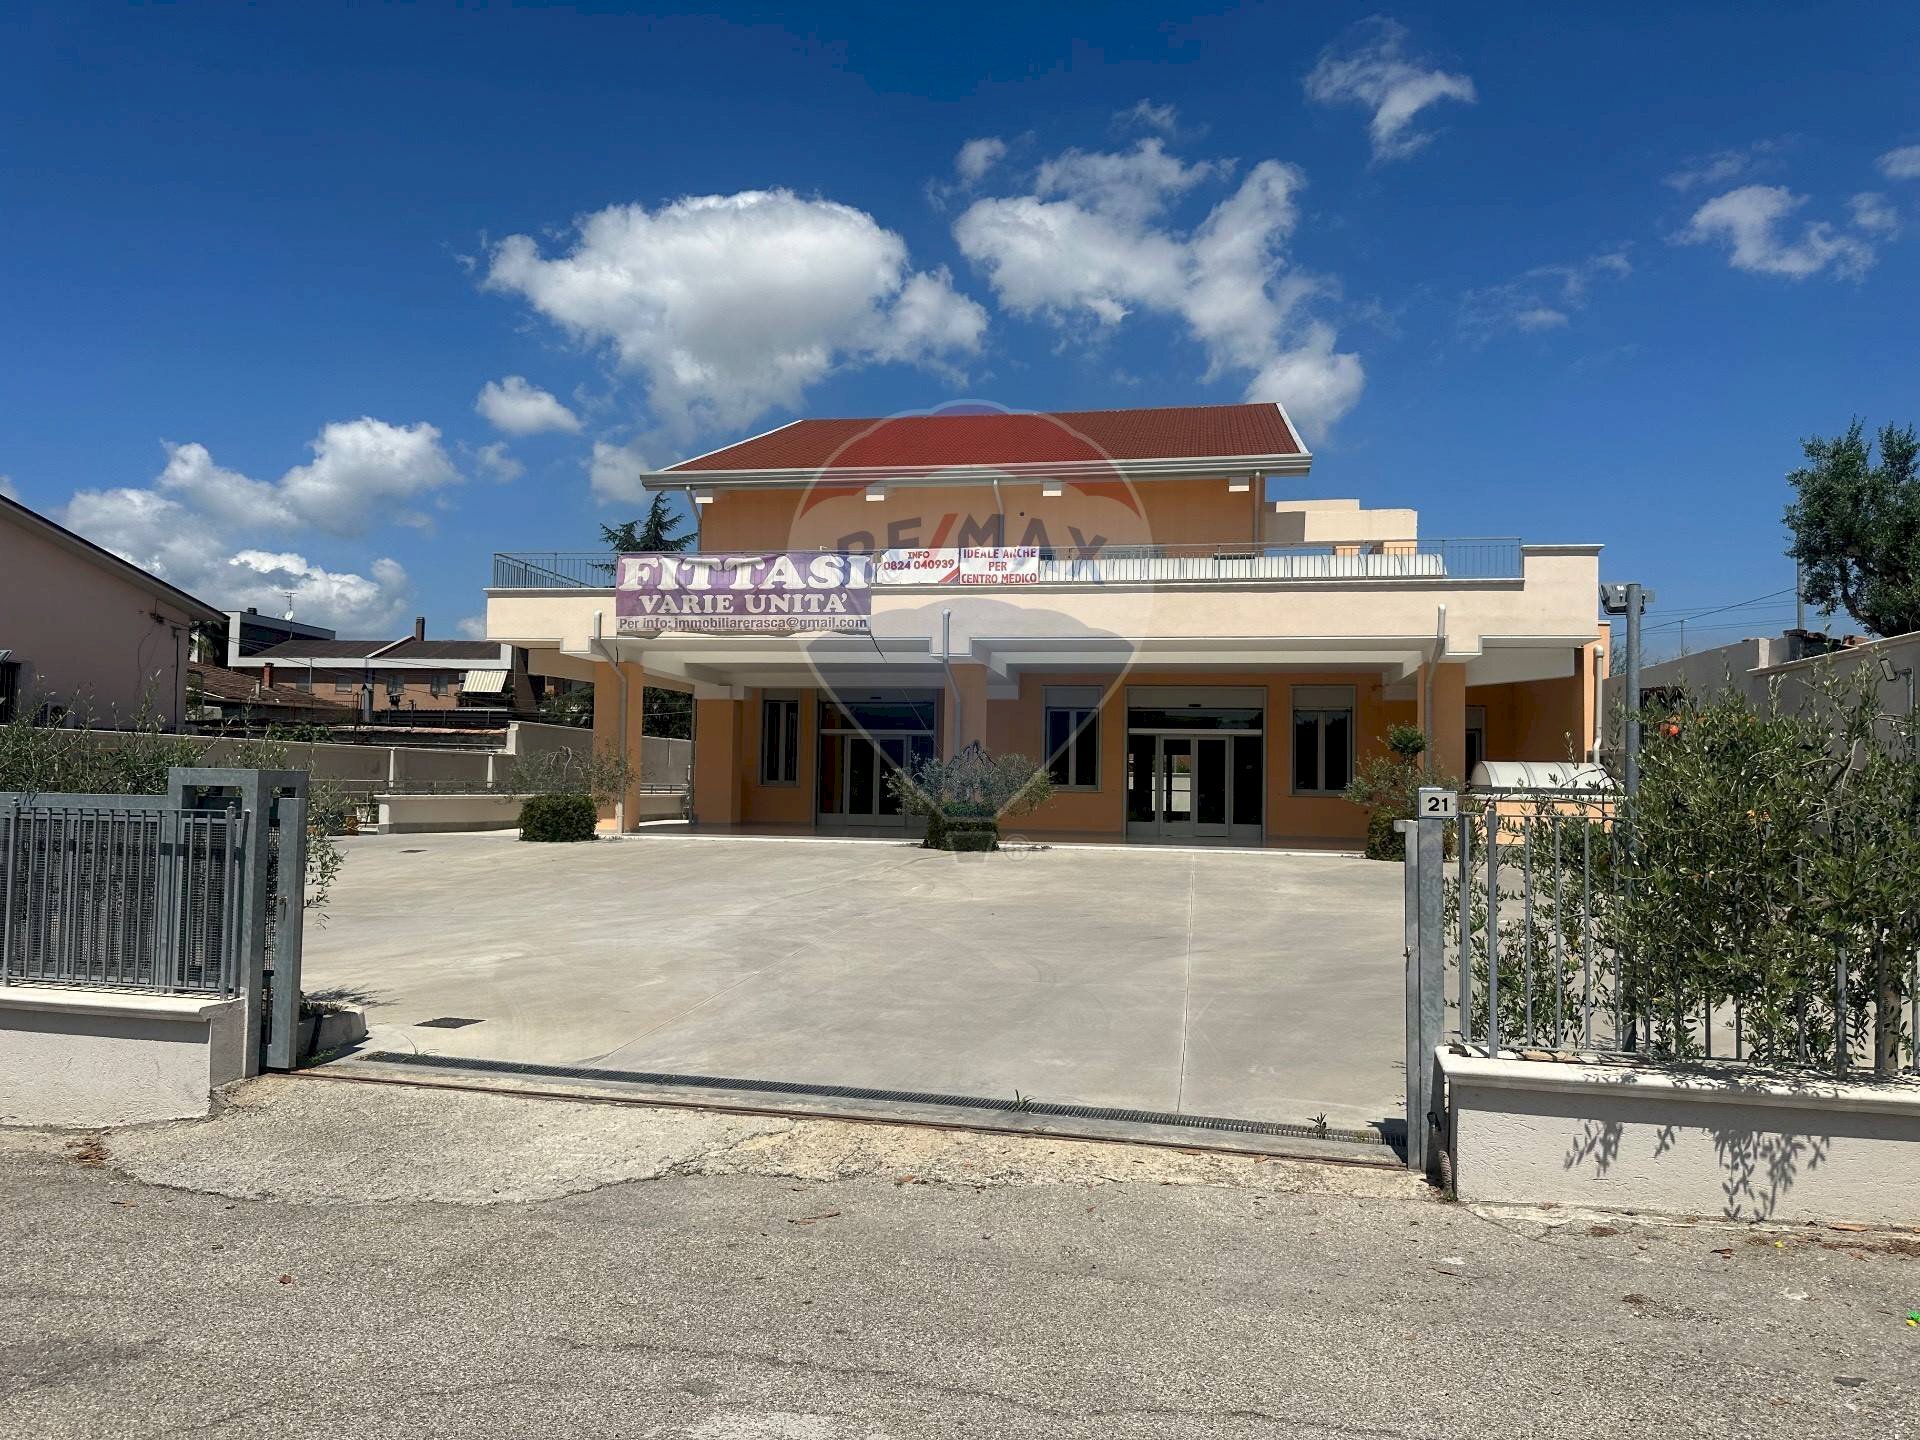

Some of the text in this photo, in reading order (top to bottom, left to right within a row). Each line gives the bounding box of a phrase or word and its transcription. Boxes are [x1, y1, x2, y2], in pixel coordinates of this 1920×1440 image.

[907, 551, 931, 559] INFO
[963, 548, 999, 559] IDEALE
[883, 559, 955, 571] 0824 040939
[988, 561, 1008, 571] PER
[618, 555, 870, 591] FITTASI
[961, 572, 1037, 584] CENTRO MEDICO
[639, 594, 734, 614] VARIE
[619, 616, 868, 630] Per info: immobiliarerasca@gmail.com
[1427, 796, 1448, 812] 21
